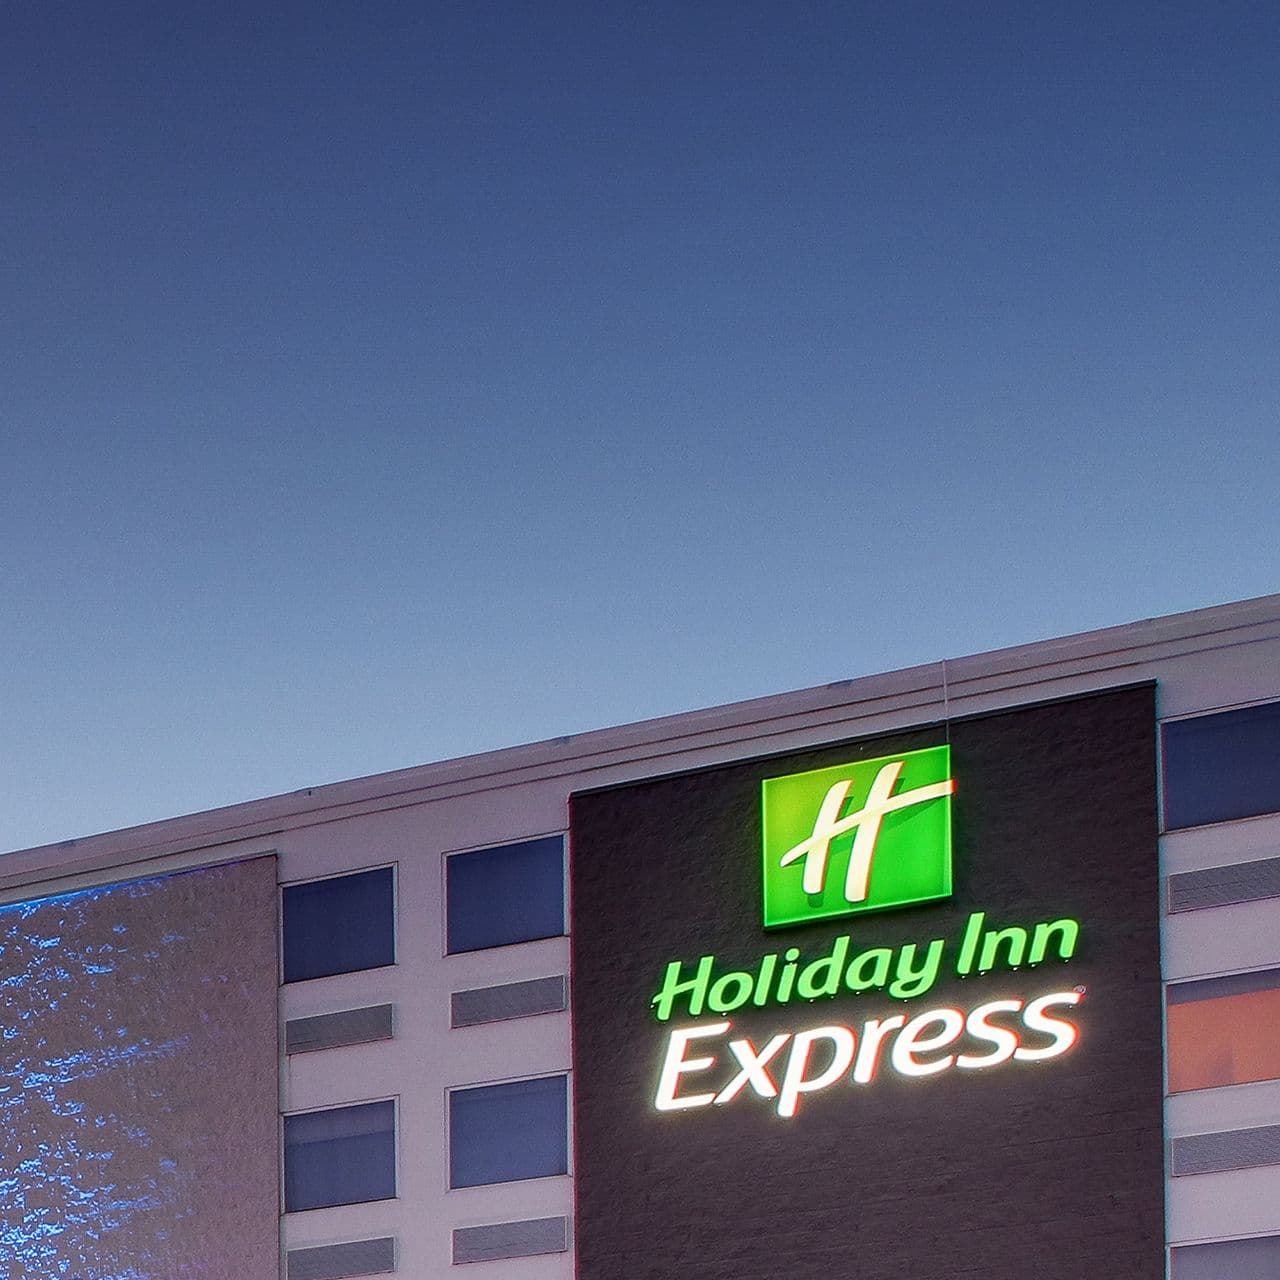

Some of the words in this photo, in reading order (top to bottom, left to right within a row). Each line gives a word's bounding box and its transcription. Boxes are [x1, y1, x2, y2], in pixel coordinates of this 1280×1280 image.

[652, 936, 944, 1020] Holiday
[957, 912, 1079, 974] Inn
[655, 992, 1083, 1117] Express
